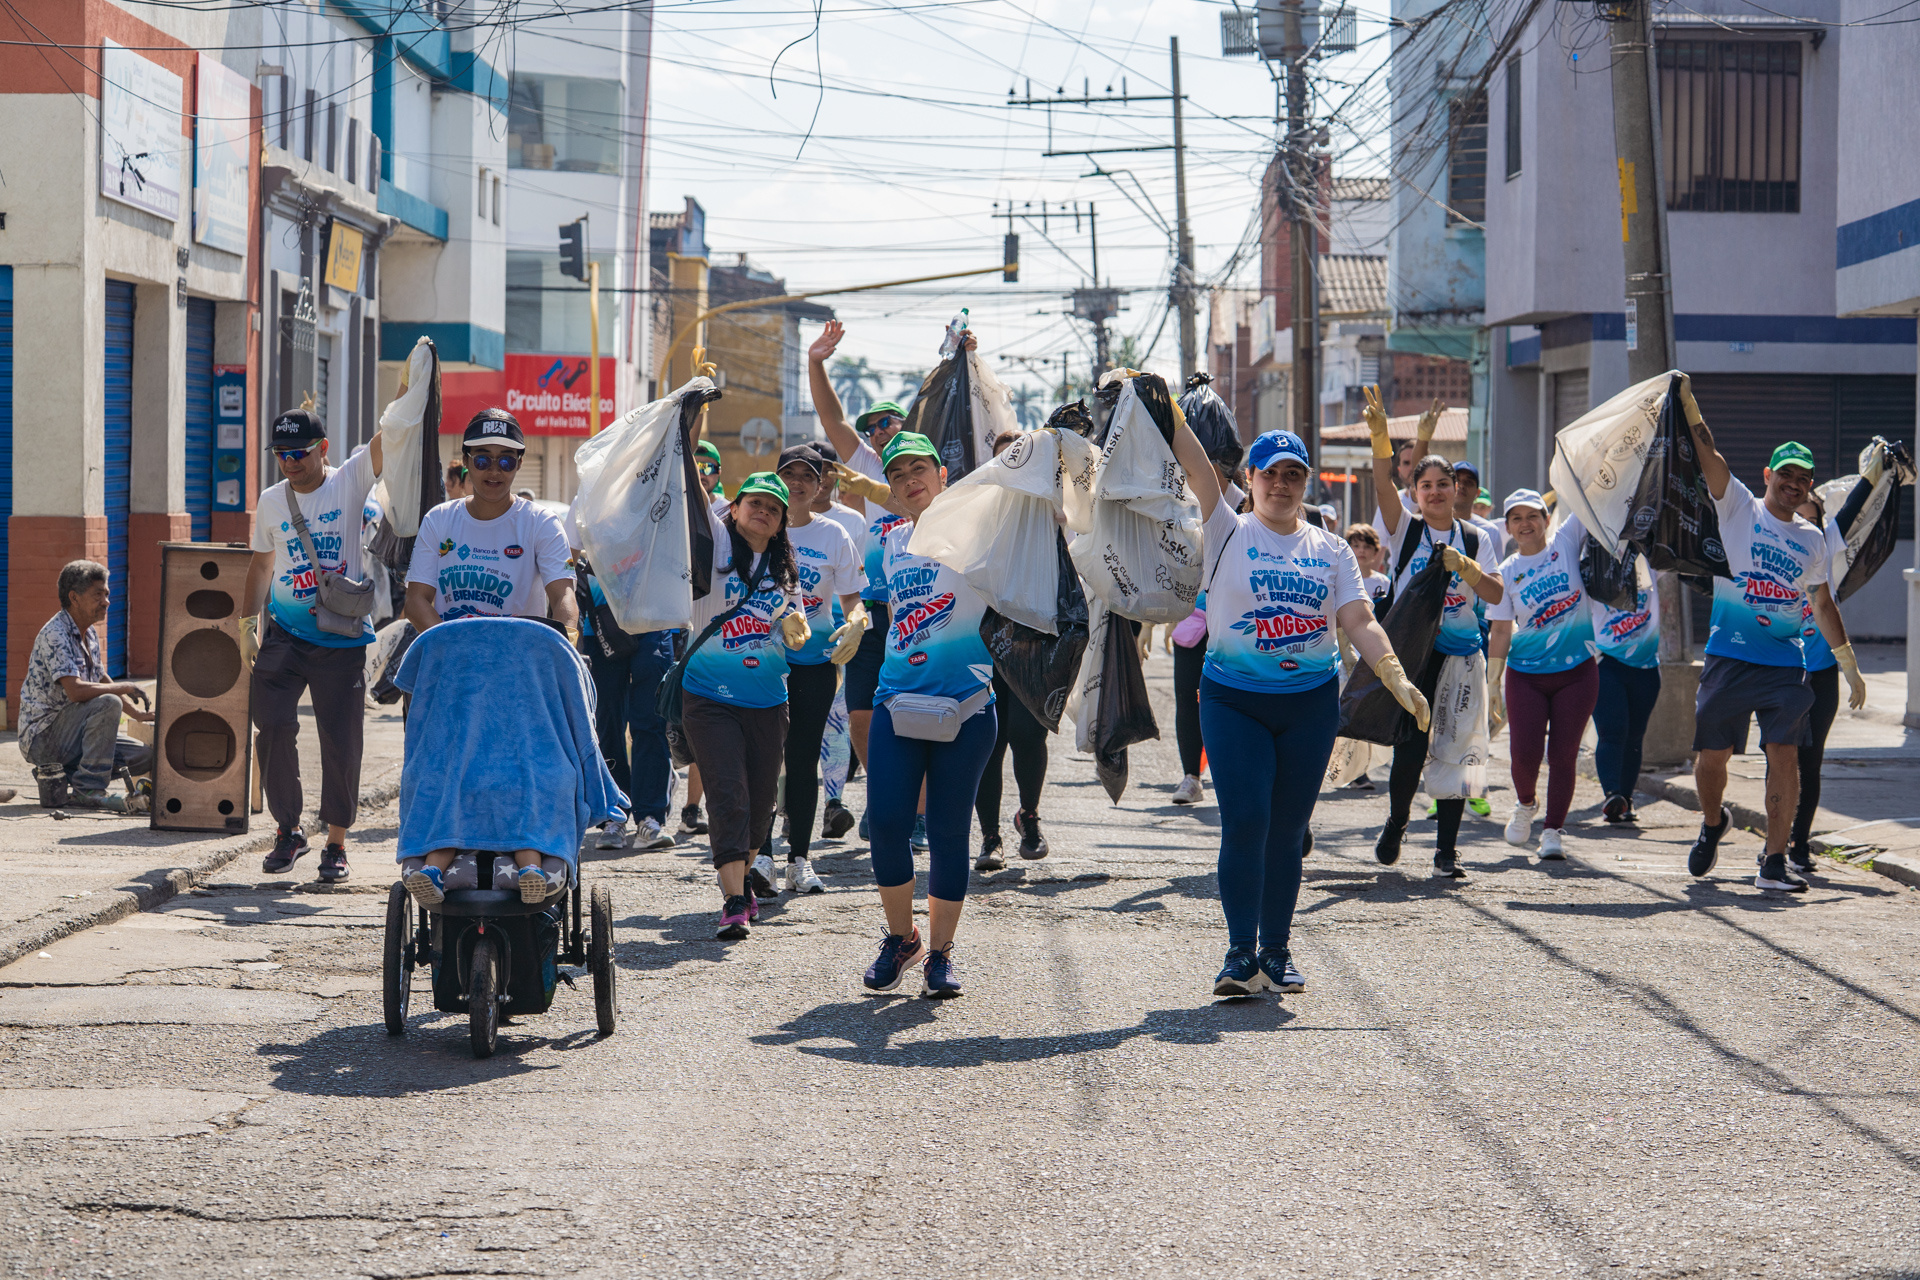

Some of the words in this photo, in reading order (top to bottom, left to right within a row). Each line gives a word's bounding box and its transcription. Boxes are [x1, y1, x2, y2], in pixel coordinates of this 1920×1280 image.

[507, 389, 559, 412] Circuito
[562, 391, 614, 413] Eléctco
[1648, 404, 1661, 424] TAS
[482, 420, 508, 436] RUN
[1103, 432, 1122, 459] TASK
[1276, 435, 1290, 448] B
[1598, 468, 1613, 487] ASK
[286, 536, 342, 558] MNDO
[473, 547, 490, 555] Banco
[1160, 529, 1189, 559] TSK,
[471, 553, 500, 562] Occidente
[1750, 546, 1804, 579] MUNDO
[440, 564, 485, 576] CORRIENDO
[486, 567, 500, 576] POR
[501, 571, 511, 580] UN
[1251, 569, 1301, 577] CORRIENDO
[438, 571, 514, 599] MUNDO
[897, 585, 934, 603] BIENEST
[1249, 574, 1329, 601] MUNDO
[1520, 572, 1569, 606] MUNDO
[444, 595, 452, 604] DE
[453, 589, 505, 610] BIENESTAR
[726, 600, 736, 608] DE
[1255, 593, 1268, 602] DE
[1269, 591, 1322, 612] BIENESTAR
[1286, 643, 1306, 655] CALI
[910, 654, 927, 664] TASK
